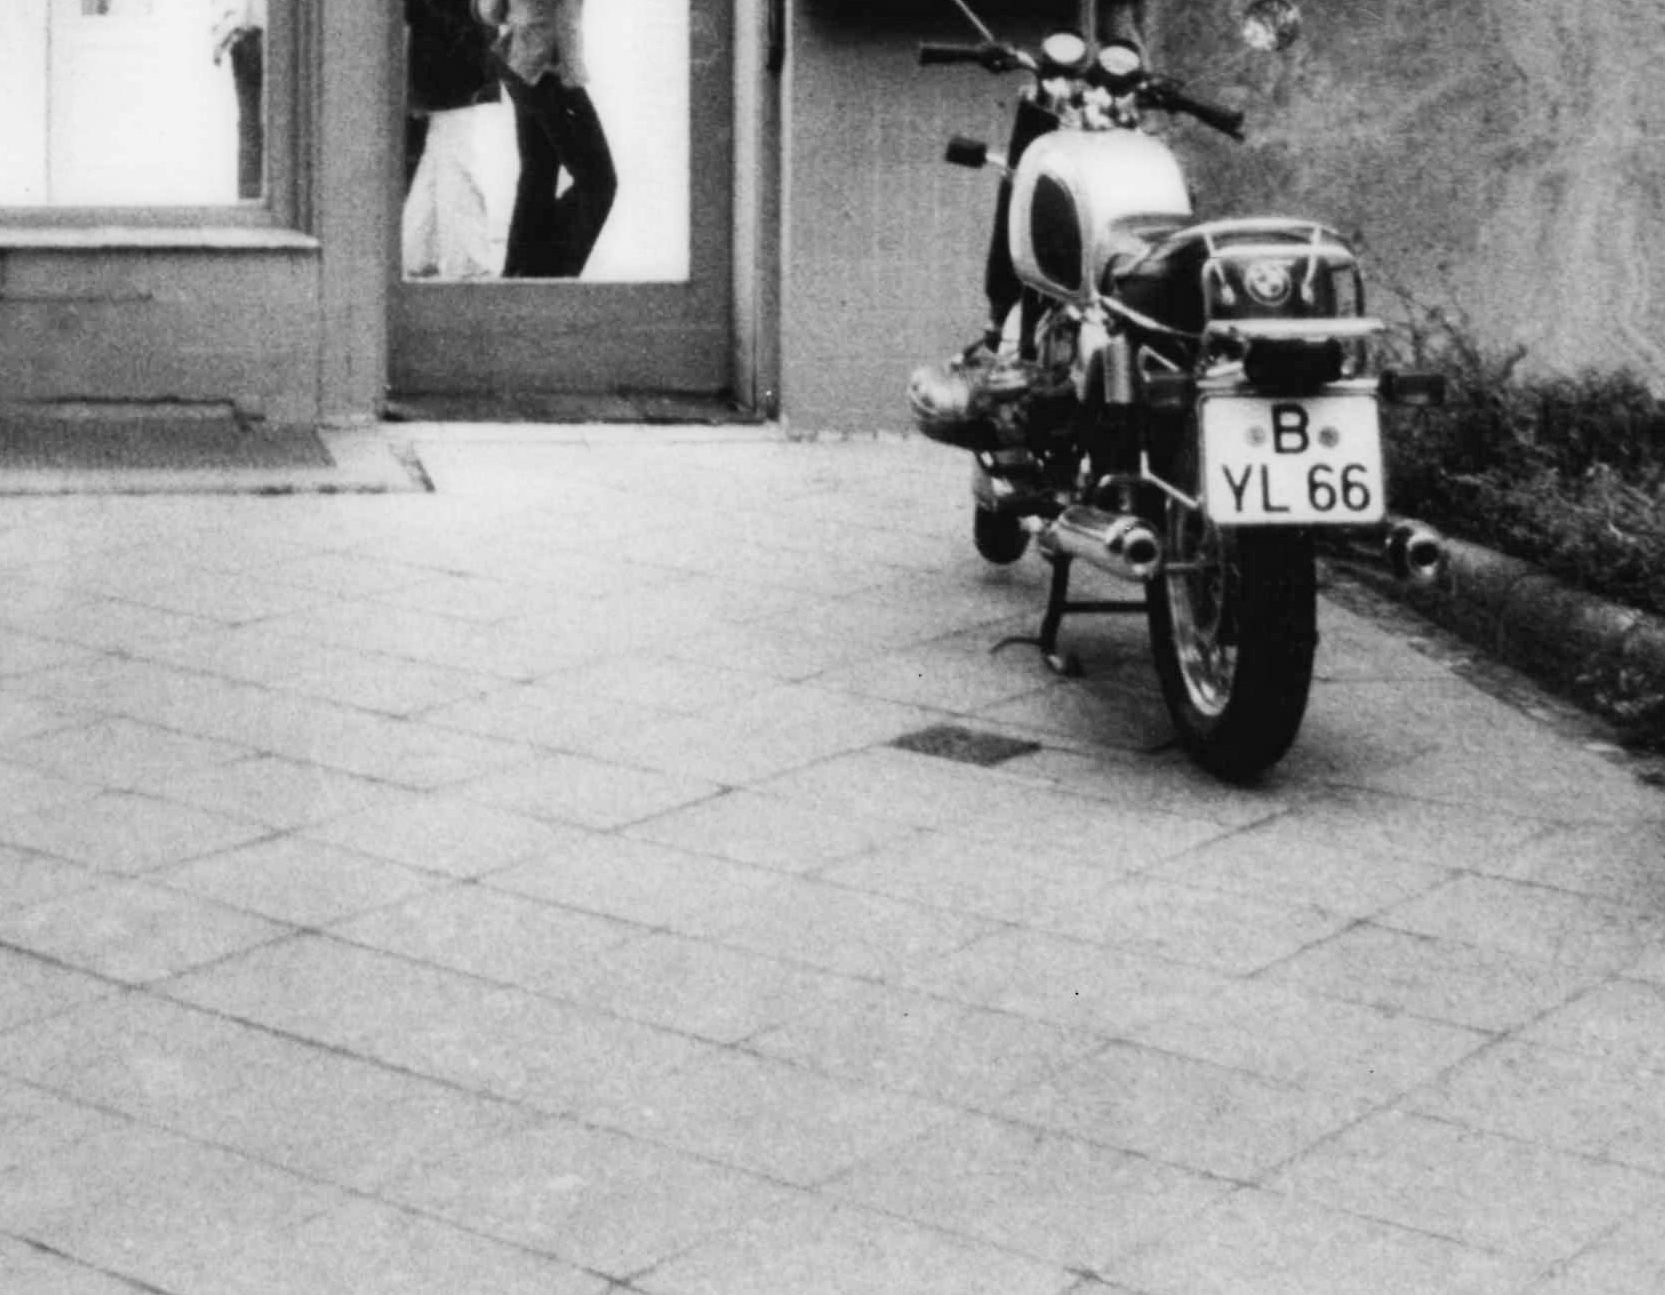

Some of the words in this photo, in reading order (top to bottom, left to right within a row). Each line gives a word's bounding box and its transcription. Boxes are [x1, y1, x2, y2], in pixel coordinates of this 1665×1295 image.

[1271, 404, 1310, 454] B
[1221, 463, 1290, 513] YL
[1307, 462, 1371, 513] 66
